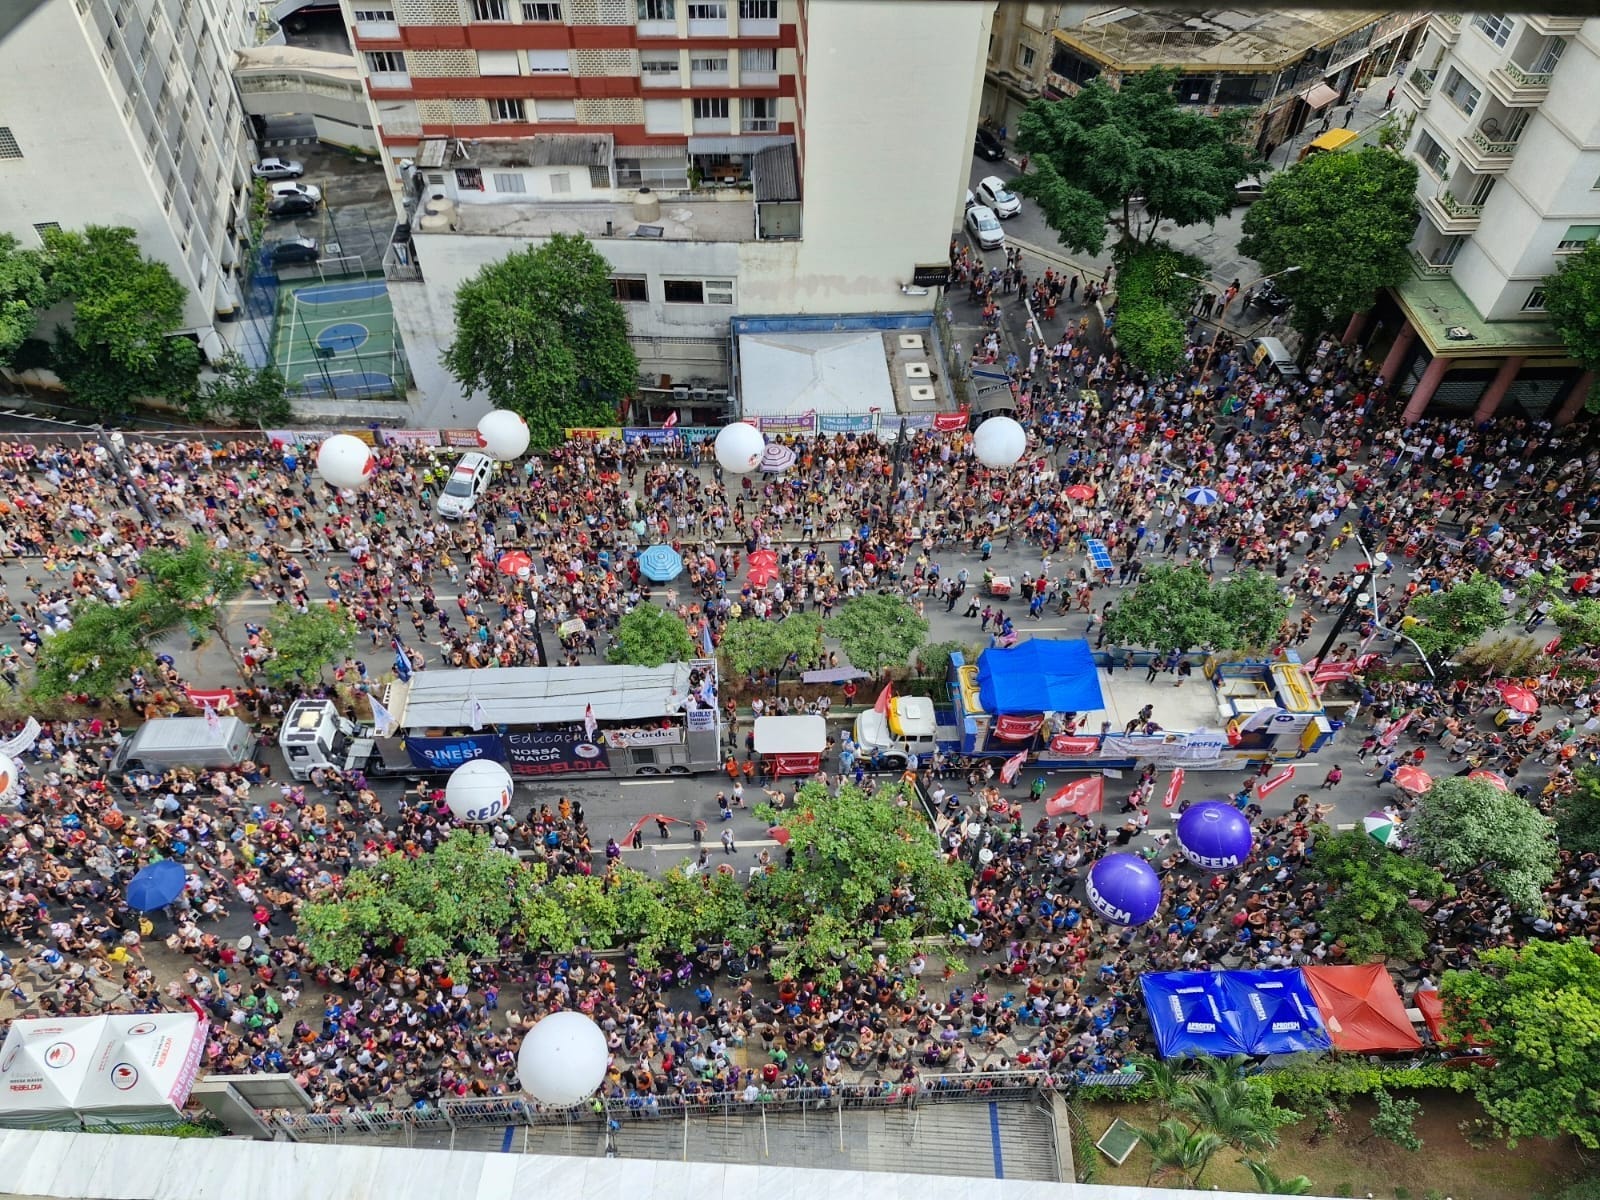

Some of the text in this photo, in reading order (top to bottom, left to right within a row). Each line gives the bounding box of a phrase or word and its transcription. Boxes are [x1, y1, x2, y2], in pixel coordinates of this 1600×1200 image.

[424, 748, 483, 760] SINESP
[510, 747, 561, 755] NOSSA
[514, 753, 561, 762] MAIOR
